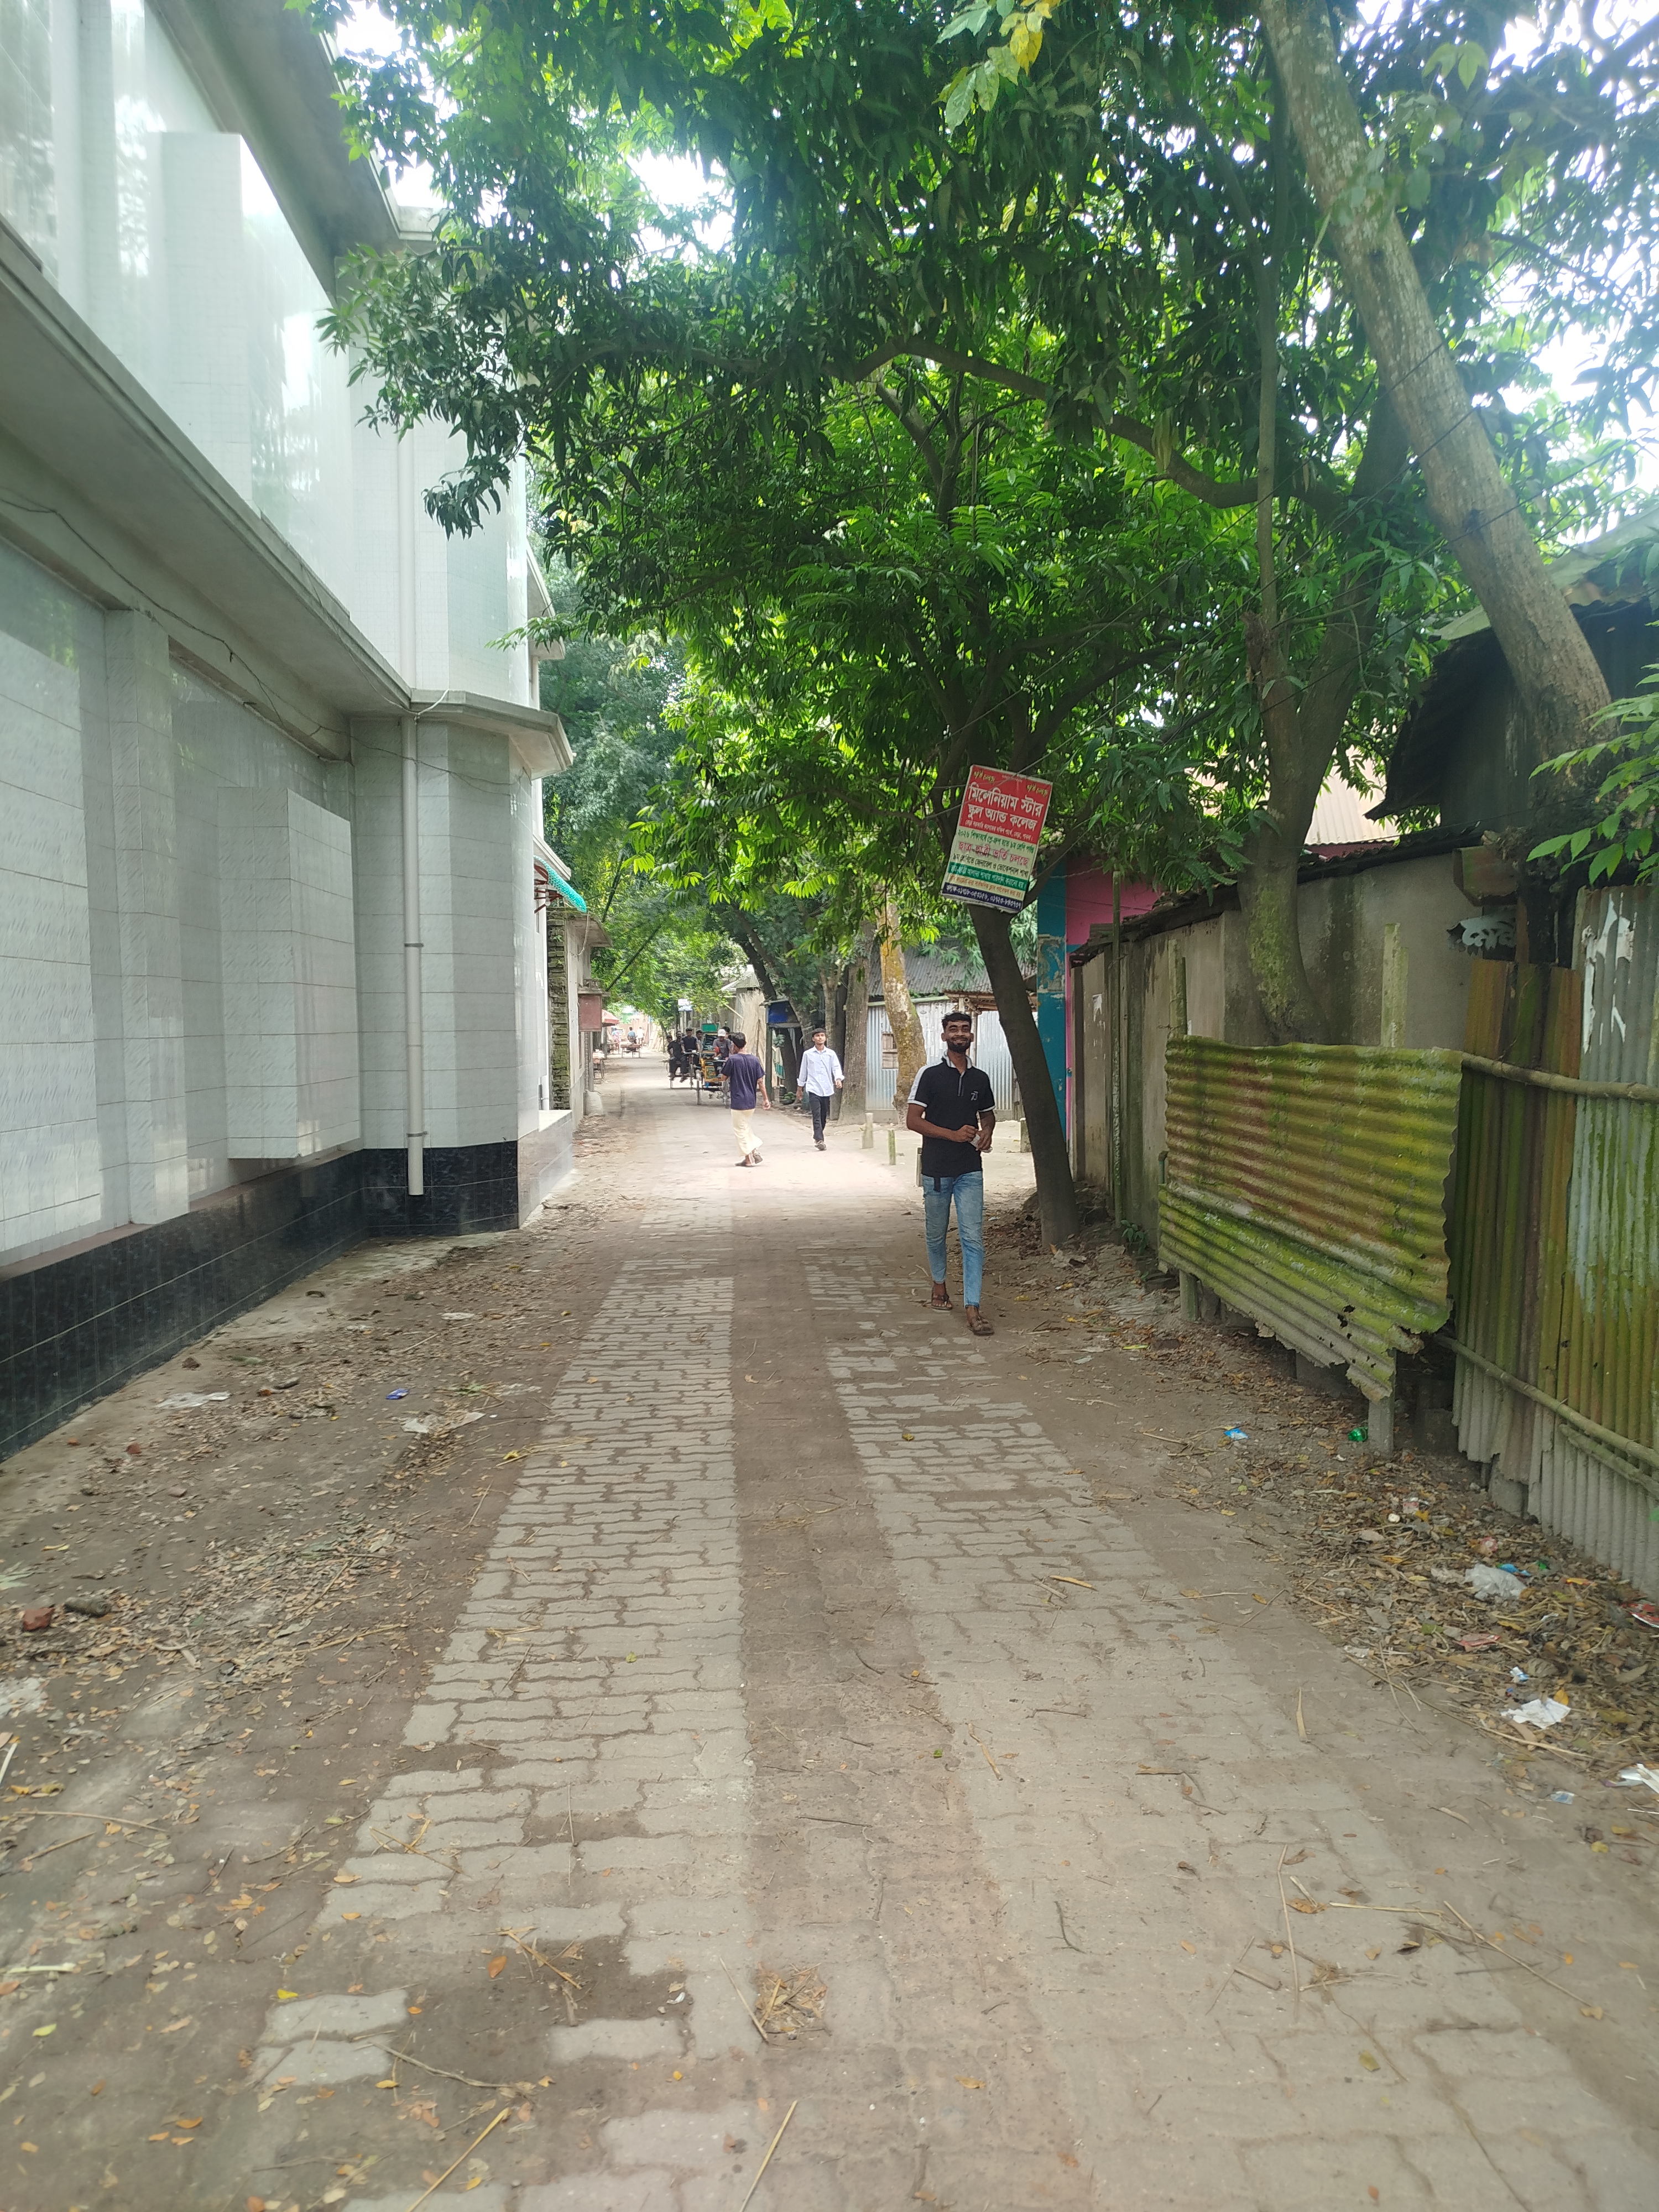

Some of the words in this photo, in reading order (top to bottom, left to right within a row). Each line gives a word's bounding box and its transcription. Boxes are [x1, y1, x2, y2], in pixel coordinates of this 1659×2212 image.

[968, 782, 1018, 810] মিলেনিয়াম
[1021, 796, 1043, 816] স্টার
[968, 804, 983, 818] স্কুল
[985, 808, 1007, 822] অ্যান্ড
[1010, 814, 1037, 830] কলেজ
[992, 848, 1009, 860] ভর্তি
[1009, 853, 1029, 866] চলছে
